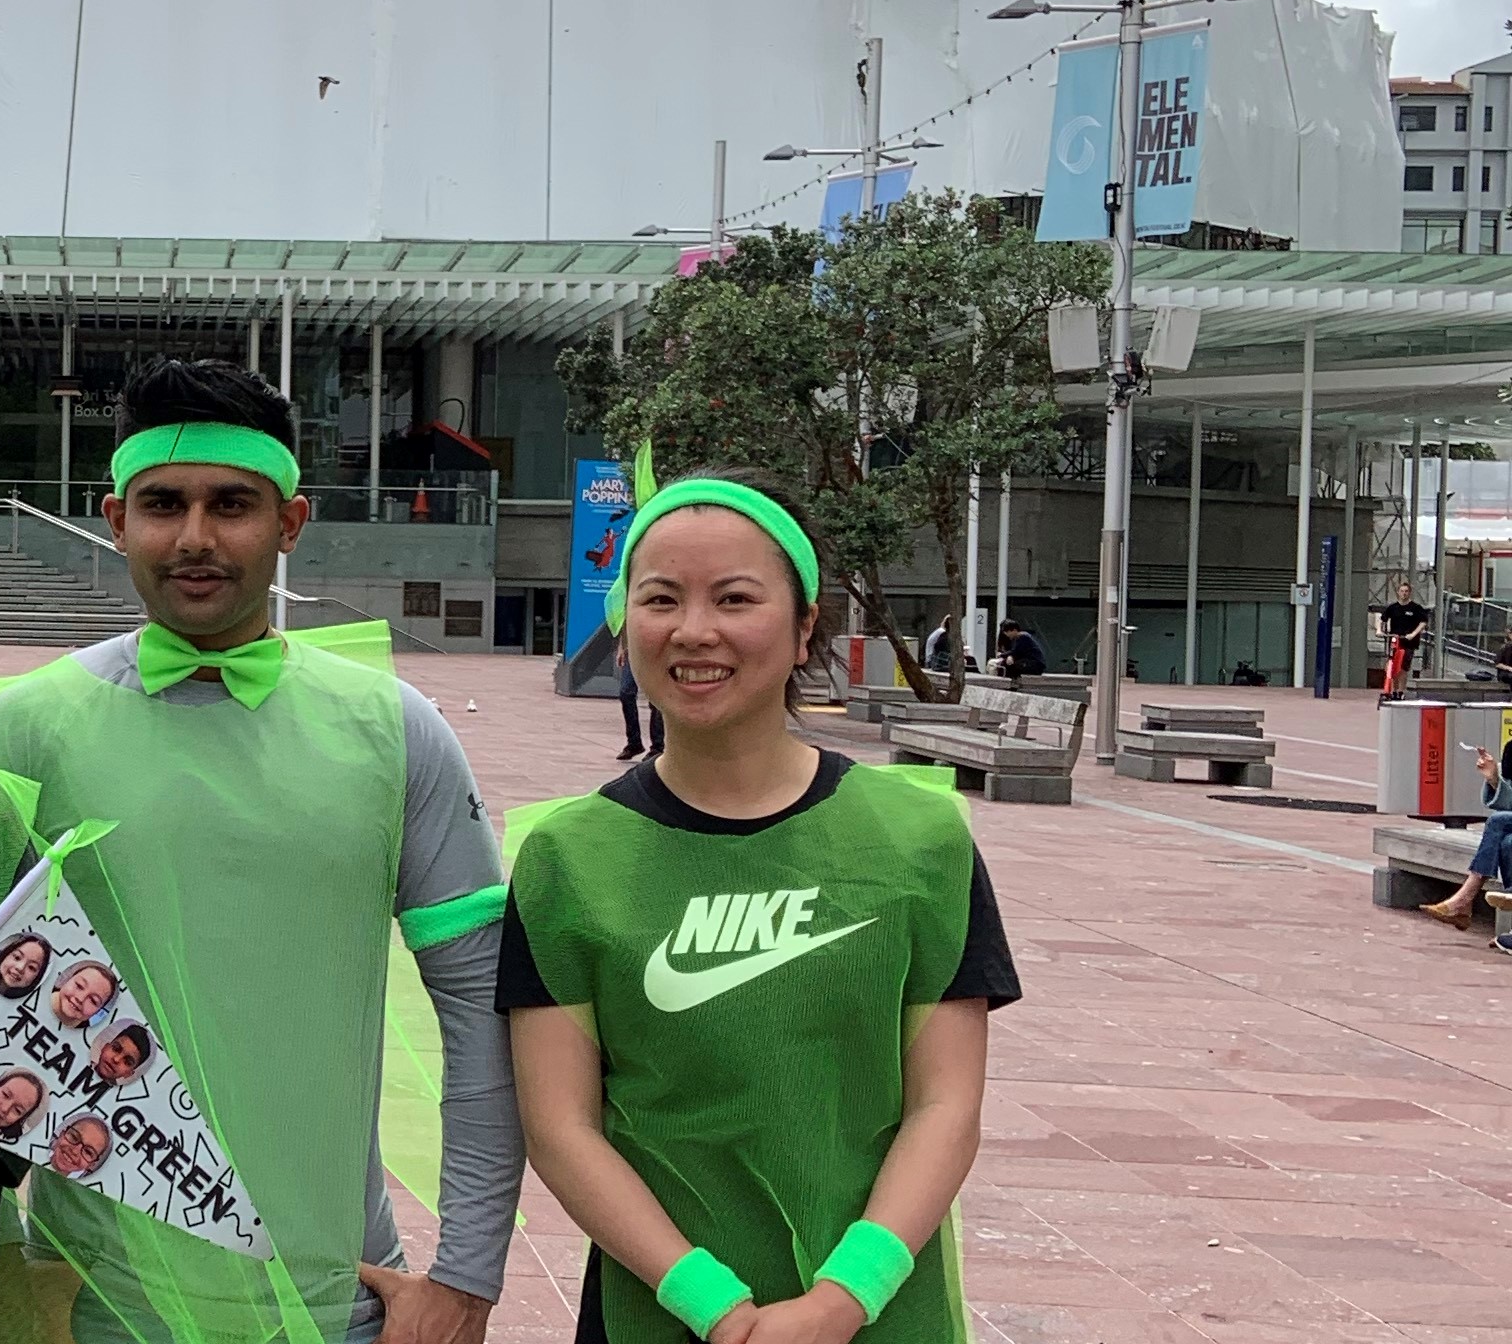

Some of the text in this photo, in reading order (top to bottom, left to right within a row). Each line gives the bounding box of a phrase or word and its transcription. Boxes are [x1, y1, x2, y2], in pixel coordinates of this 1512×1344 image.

[1142, 77, 1190, 117] ELE
[1138, 112, 1198, 152] MEN
[1136, 151, 1192, 188] TAL.
[74, 404, 99, 417] Box
[582, 489, 628, 504] POPPIN
[591, 479, 624, 492] MARY
[977, 614, 984, 624] 2
[1425, 743, 1439, 785] Litter
[671, 887, 819, 955] NIKE
[7, 1005, 114, 1108] TEAM
[111, 1105, 236, 1223] GREEN
